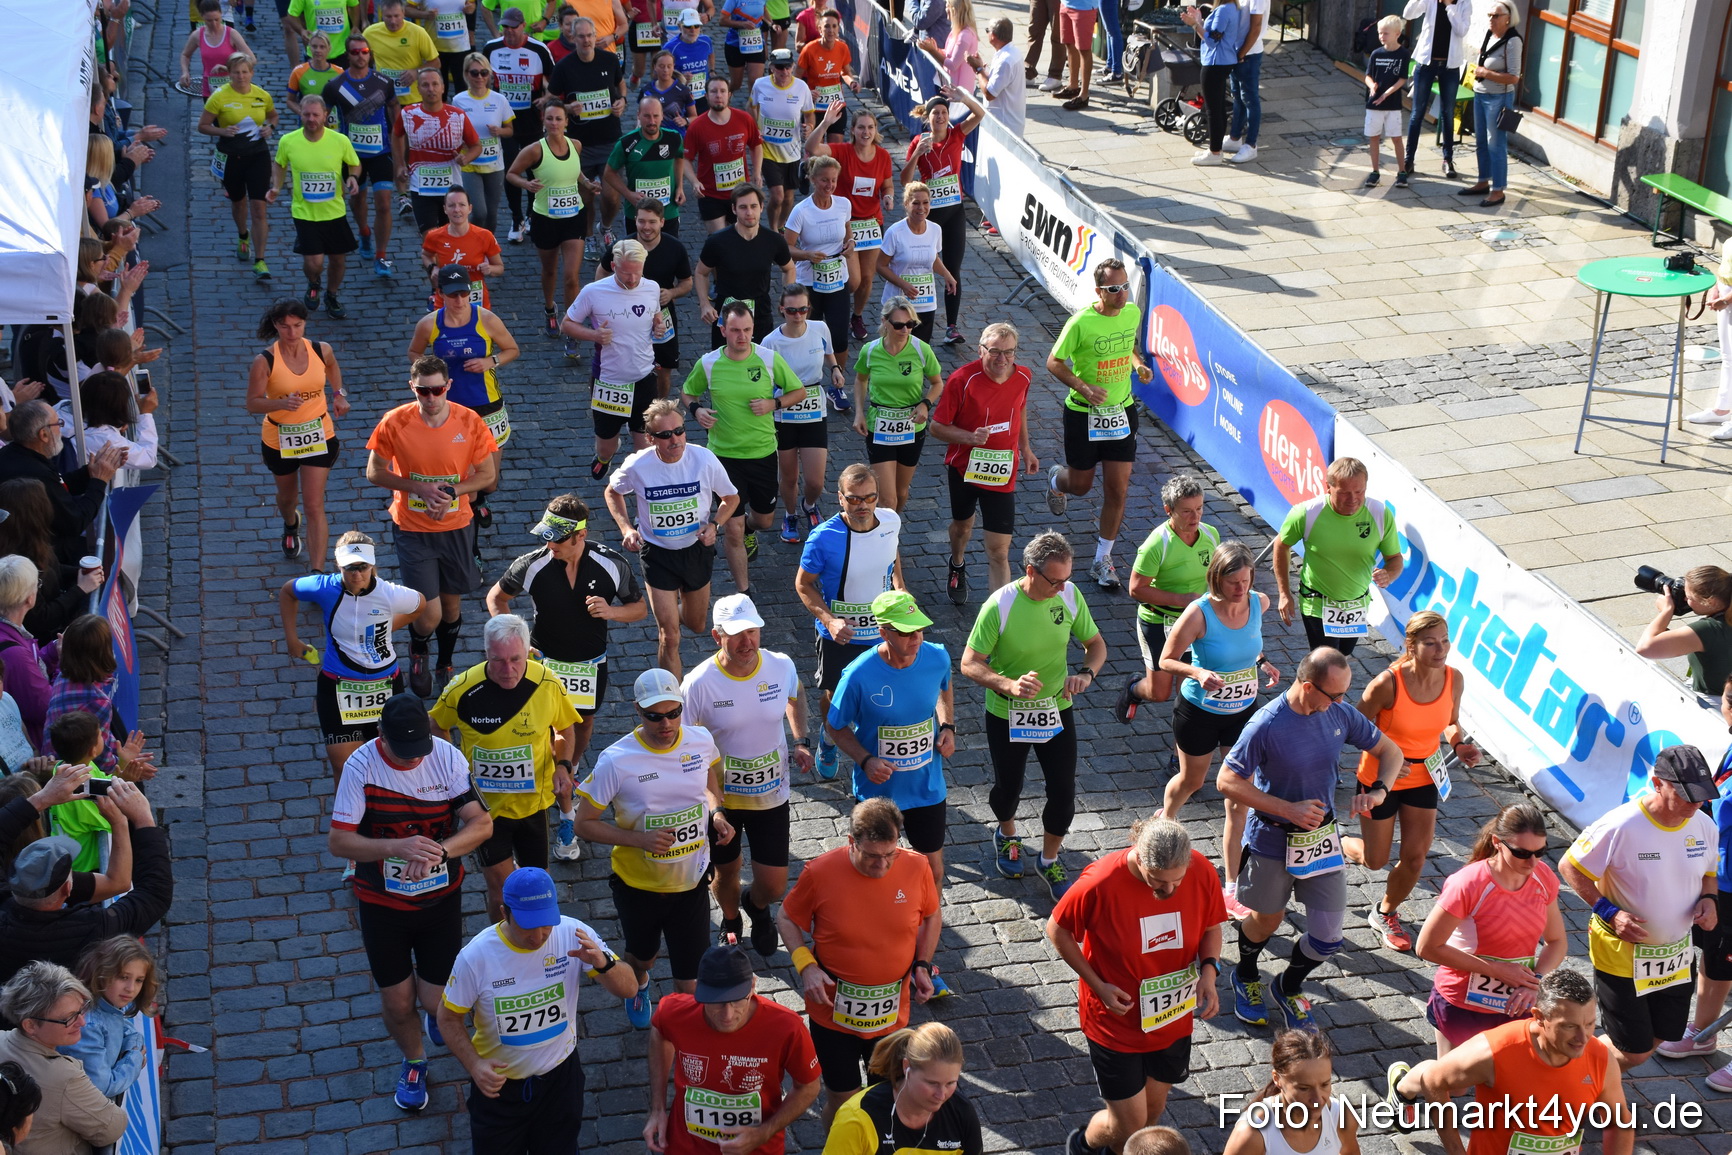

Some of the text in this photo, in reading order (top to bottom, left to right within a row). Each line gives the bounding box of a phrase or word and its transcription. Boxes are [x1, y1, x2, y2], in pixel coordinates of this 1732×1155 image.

[319, 17, 342, 25] 2236
[439, 22, 461, 31] 2811
[742, 38, 761, 46] 2459
[682, 60, 708, 70] SYSCAD
[578, 92, 608, 100] BOCK
[582, 100, 609, 110] 1145
[351, 126, 381, 134] BOCK
[766, 128, 791, 137] 2776
[352, 134, 380, 144] 2707
[420, 168, 452, 176] BOCK
[720, 168, 742, 182] 1116
[304, 182, 332, 192] 2727
[422, 176, 450, 186] 2725
[550, 187, 578, 196] BOCK
[930, 187, 956, 198] 2564
[553, 196, 579, 208] 2658
[851, 220, 877, 228] BOCK
[1020, 193, 1073, 263] swn
[853, 229, 879, 240] 2716
[816, 270, 840, 282] 2157
[1049, 260, 1078, 296] neumarkt
[1151, 312, 1206, 390] Hervis
[1097, 356, 1130, 370] MERZ
[1096, 366, 1130, 378] PREMIUM
[1214, 362, 1238, 386] STORE
[597, 388, 628, 405] 1139
[1222, 388, 1244, 416] ONLINE
[596, 402, 626, 413] ANDREAS
[283, 422, 318, 432] BOCK
[879, 420, 912, 434] 2484
[1094, 416, 1124, 428] 2065
[1096, 429, 1125, 437] MICHAEL
[1220, 414, 1242, 444] MOBILE
[286, 432, 320, 446] 1303
[885, 434, 905, 442] HEIKE
[294, 446, 314, 454] IRENE
[974, 450, 1010, 460] BOCK
[1264, 406, 1325, 498] Hervis
[974, 462, 1008, 474] 1306
[974, 474, 1001, 482] ROBERT
[652, 485, 698, 498] STAEDTLER
[654, 499, 694, 513] BOCK
[656, 512, 695, 528] 2093
[664, 527, 689, 536] JOSEF
[1327, 610, 1363, 626] 2487
[1330, 626, 1358, 634] HUBERT
[342, 682, 387, 692] BOCK
[758, 684, 768, 692] 20
[1212, 684, 1252, 700] 2254
[344, 692, 386, 708] 1138
[1217, 700, 1244, 709] KARIN
[345, 710, 382, 718] FRANZISK
[471, 716, 502, 724] Norbert
[1016, 711, 1056, 727] 2485
[884, 722, 929, 738] BOCK
[1020, 729, 1054, 738] LUDWIG
[885, 737, 929, 756] 2639
[477, 748, 528, 760] BOCK
[730, 753, 774, 770] BOCK
[894, 756, 922, 766] KLAUS
[479, 763, 526, 779] 2291
[731, 766, 774, 784] 2631
[482, 780, 526, 789] NORBERT
[730, 781, 777, 793] CHRISTIAN
[650, 808, 698, 826] BOCK
[1292, 828, 1332, 846] BOCK
[1685, 838, 1696, 847] 20
[1294, 838, 1333, 864] 2789
[1641, 941, 1687, 957] BOCK
[544, 957, 556, 967] 20
[1642, 952, 1684, 976] 1147
[1147, 972, 1189, 990] BOCK
[841, 985, 898, 998] BOCK
[501, 984, 560, 1012] BOCK
[1149, 985, 1192, 1014] 1317
[844, 1000, 894, 1017] 1219
[1154, 1004, 1186, 1024] MARTIN
[505, 1004, 561, 1034] 2779
[844, 1016, 888, 1028] FLORIAN
[728, 1060, 760, 1068] STADTLAUF
[730, 1055, 768, 1064] NEUMARKTER
[692, 1088, 753, 1108] BOCK
[694, 1108, 753, 1126] 1198
[1519, 1136, 1575, 1150] BOCK
